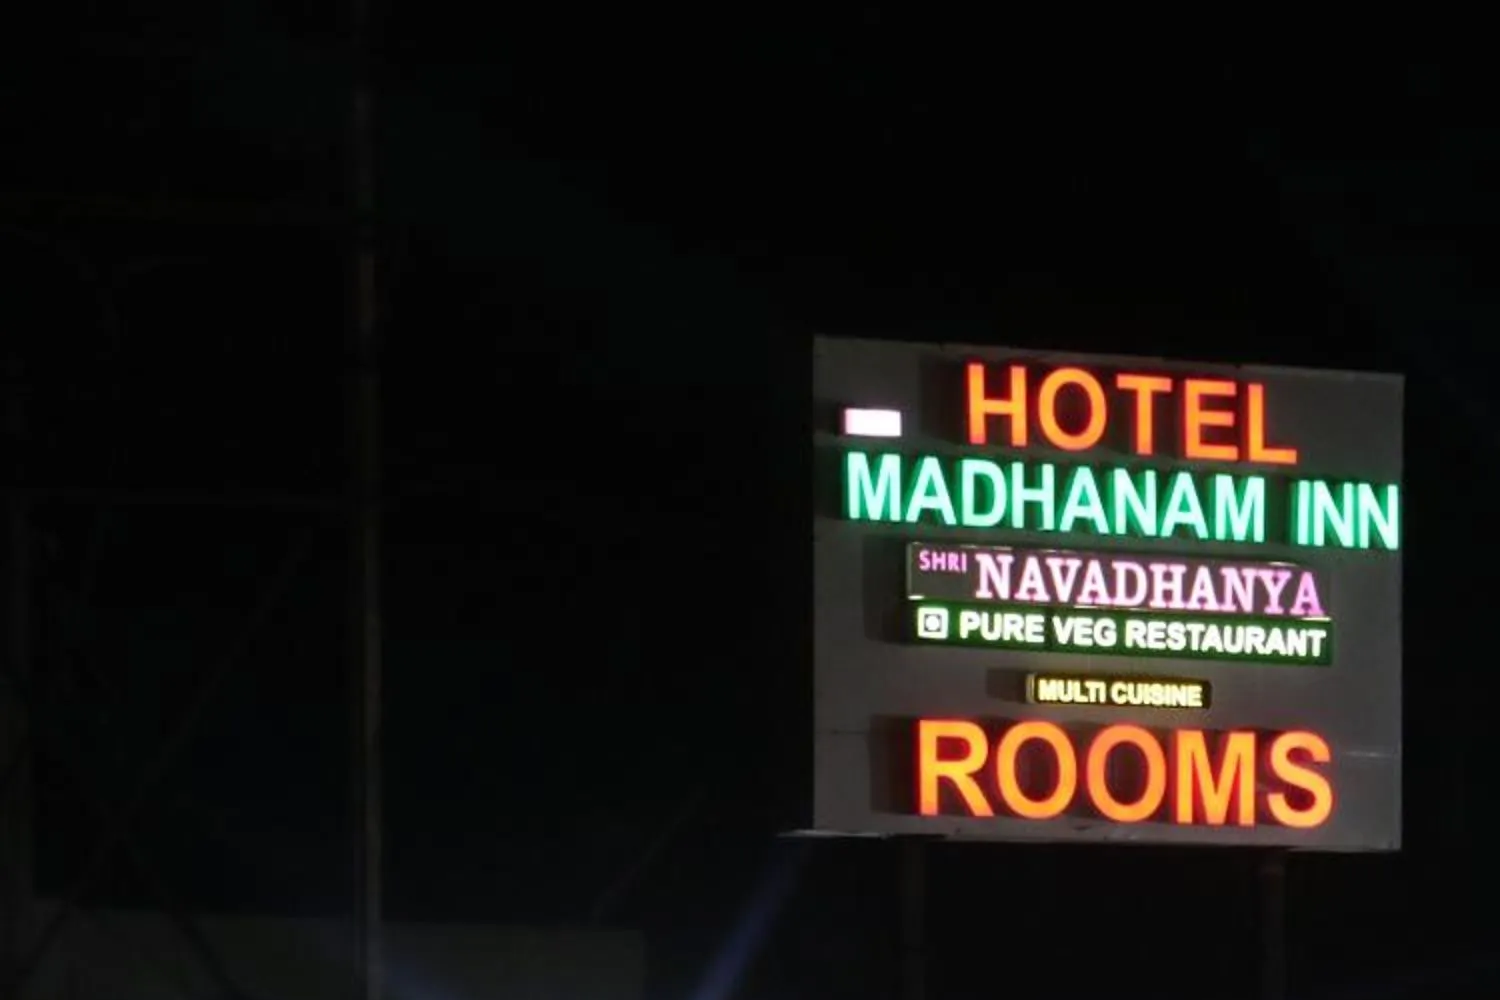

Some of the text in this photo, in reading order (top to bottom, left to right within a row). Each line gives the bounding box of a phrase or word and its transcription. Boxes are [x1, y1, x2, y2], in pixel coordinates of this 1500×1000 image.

[966, 362, 1298, 466] HOTEL
[843, 450, 1400, 551] MADHANAM INN
[918, 549, 1326, 617] SHRI NAVADHANYA
[959, 613, 1327, 658] PURE VEG RESTAURANT
[1037, 678, 1204, 708] MULTI CUISINE
[917, 716, 1335, 830] ROOMS
